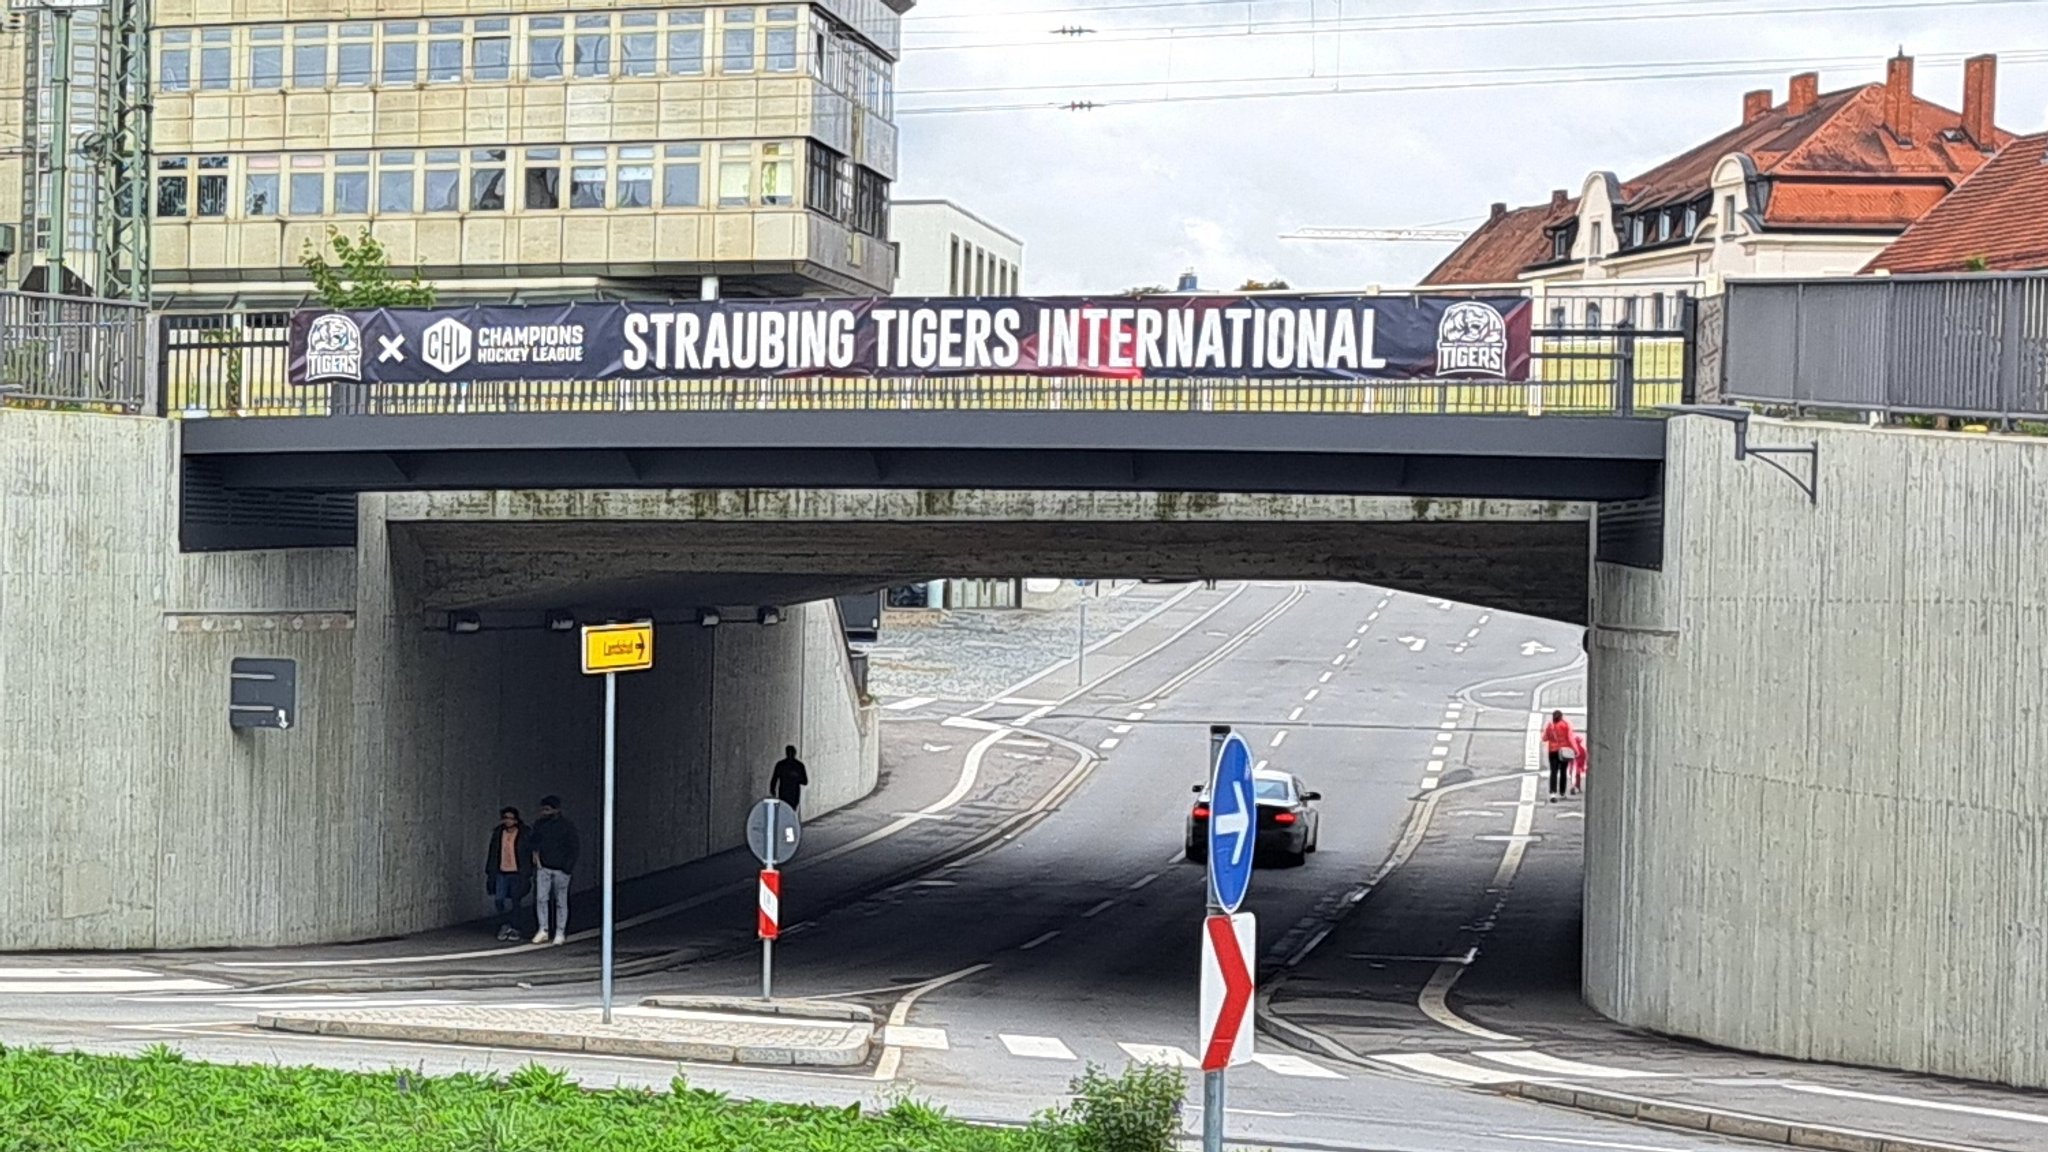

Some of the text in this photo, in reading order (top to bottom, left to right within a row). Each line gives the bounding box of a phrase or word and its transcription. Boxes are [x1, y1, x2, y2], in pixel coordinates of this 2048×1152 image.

[427, 323, 468, 367] CHL
[478, 325, 584, 347] CHAMPIONS
[623, 307, 1386, 371] STRAUBING TIGERS INTERNATIONAL
[309, 355, 358, 375] TIGERS
[478, 345, 584, 363] HOCKEY LEAGUE
[1440, 347, 1502, 369] TIGERS
